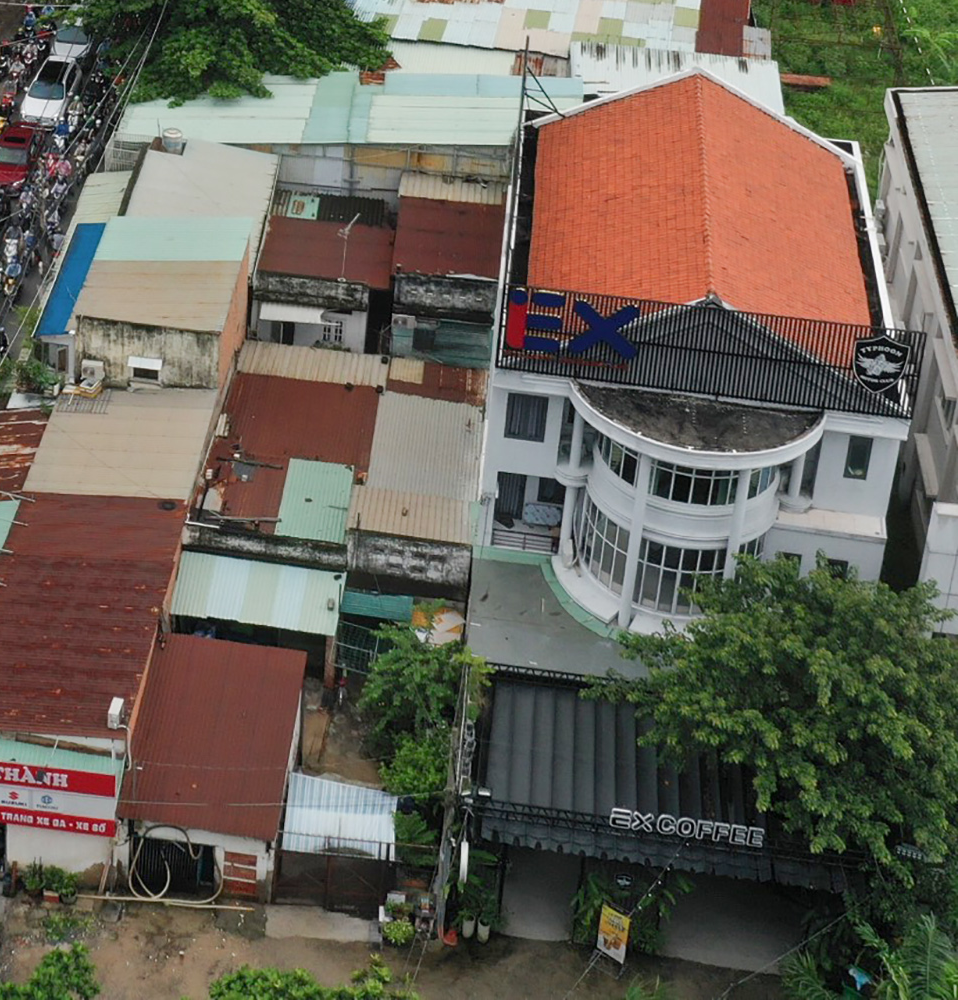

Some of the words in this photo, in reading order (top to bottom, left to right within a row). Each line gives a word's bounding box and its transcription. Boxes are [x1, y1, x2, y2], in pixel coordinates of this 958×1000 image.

[860, 345, 903, 358] TYPHOON
[1, 811, 33, 823] TRANG
[36, 816, 50, 825] XE
[76, 821, 89, 831] XE
[609, 807, 654, 833] EX
[656, 814, 765, 848] COFFEE
